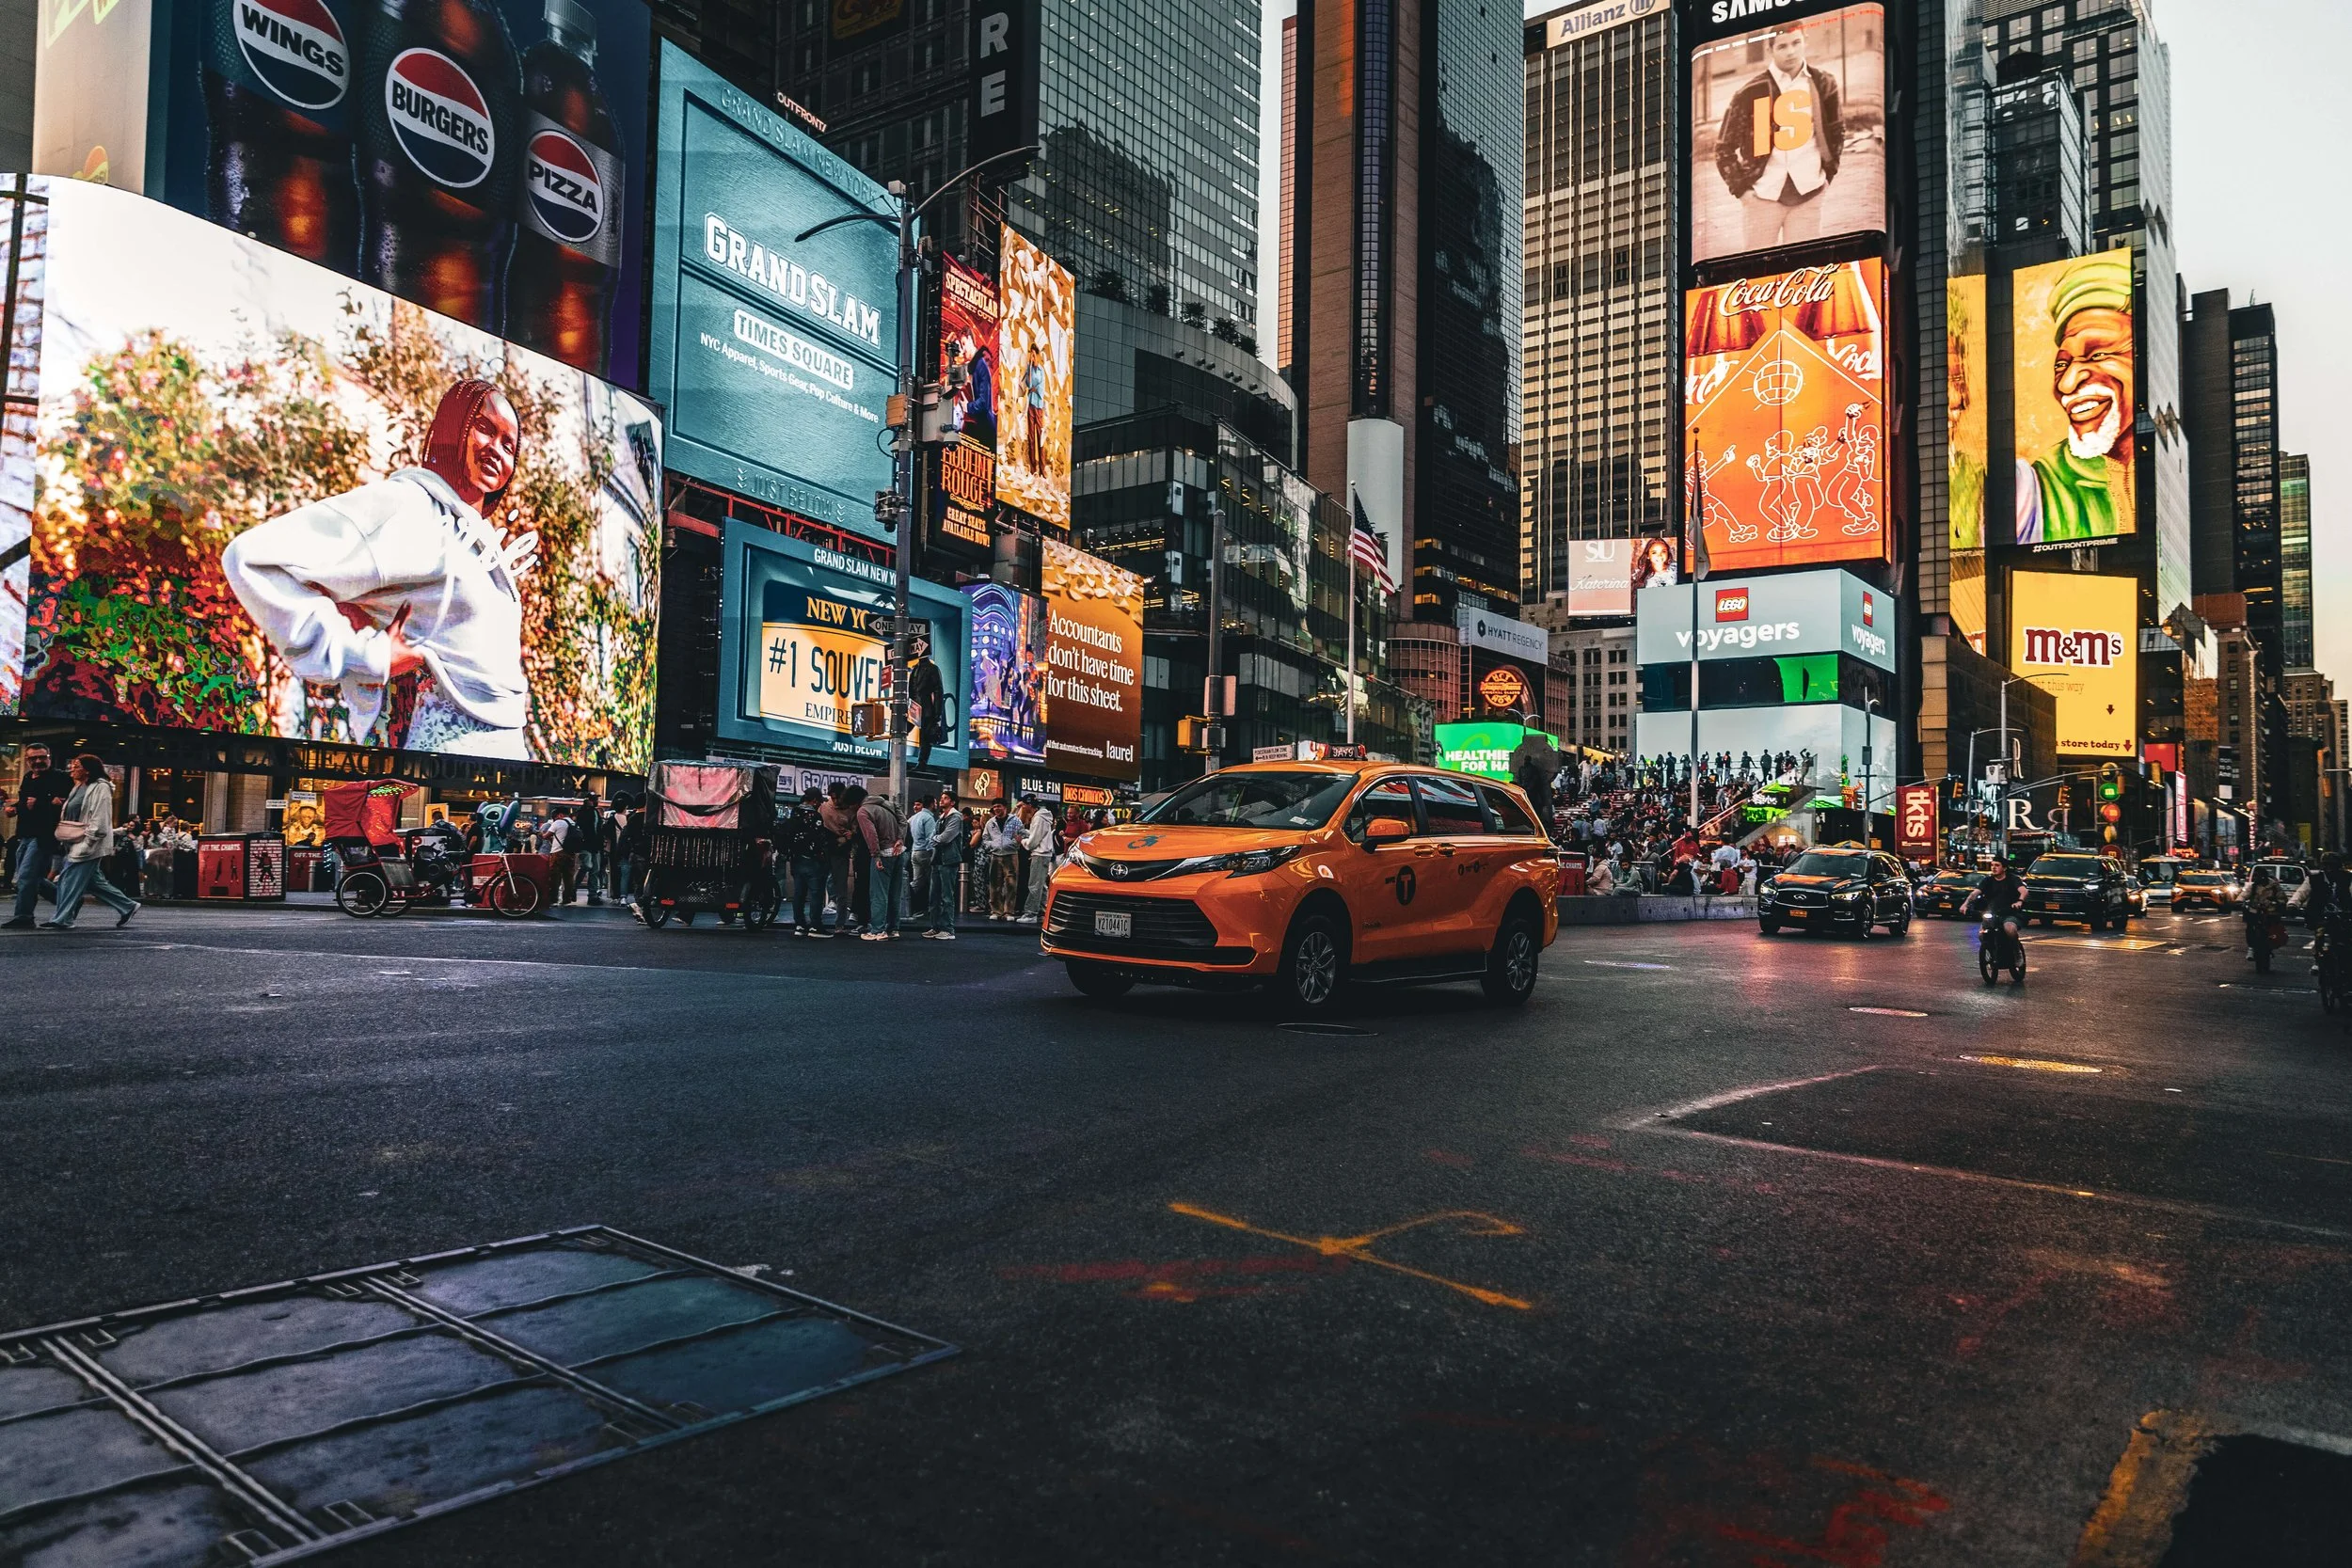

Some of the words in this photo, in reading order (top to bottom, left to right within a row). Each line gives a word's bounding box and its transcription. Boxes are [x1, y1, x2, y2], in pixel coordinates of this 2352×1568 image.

[1560, 3, 1627, 39] Allianz
[241, 2, 345, 78] WINGS
[391, 85, 489, 156] BURGERS
[1753, 88, 1814, 158] IS
[720, 86, 774, 136] GRAND
[774, 123, 812, 162] SLAM
[814, 149, 844, 183] NEW
[845, 166, 879, 206] YORK
[528, 158, 598, 214] PIZZA
[705, 211, 808, 309] GRAND
[808, 271, 882, 350] SLAM
[945, 271, 998, 319] SPECTACULAR
[1718, 262, 1840, 318] Coca-Cola
[949, 292, 977, 313] NIGHT
[738, 314, 788, 355] TIMES
[792, 341, 850, 386] SQUARE
[700, 331, 721, 353] NYC
[721, 342, 758, 372] Apparel,
[758, 359, 787, 383] Sports
[788, 372, 809, 394] Gear,
[809, 382, 825, 401] Pop
[825, 390, 853, 412] Culture
[860, 405, 880, 424] More
[942, 445, 987, 480] MOULIN
[750, 471, 785, 499] JUST
[788, 486, 835, 517] BELOW
[942, 518, 975, 543] AVAILABLE
[974, 531, 991, 547] NOW!
[946, 506, 968, 526] GREAT
[967, 514, 987, 532] SEATS
[1584, 541, 1615, 561] SU
[2031, 537, 2118, 554] #OUTFRONTPRIME
[814, 547, 846, 573] GRAND
[846, 558, 869, 578] SLAM
[870, 566, 889, 584] NEW
[1569, 574, 1629, 592] Katerina
[806, 595, 848, 626] NEW
[1717, 594, 1748, 613] LEGO
[875, 621, 895, 631] ONE
[1048, 609, 1122, 654] Accountants
[1487, 626, 1512, 642] HYATT
[1512, 631, 1544, 651] REGENCY
[1676, 621, 1801, 652] voyagers
[1851, 623, 1886, 657] voyagers
[769, 637, 798, 688] #1
[1048, 641, 1080, 672] don't
[1081, 648, 1108, 680] have
[1108, 658, 1135, 686] time
[1047, 670, 1067, 699] for
[1067, 675, 1089, 705] this
[1089, 683, 1123, 712] sheet.
[2047, 679, 2065, 692] this
[2066, 681, 2086, 695] way
[804, 702, 852, 726] EMPIRE
[1105, 740, 1134, 762] laurel
[2060, 738, 2089, 749] store
[2090, 740, 2121, 752] today
[1460, 761, 1487, 771] FOR
[1021, 777, 1044, 793] BLUE
[1046, 781, 1061, 795] FIN
[1065, 786, 1077, 801] DOS
[1077, 788, 1104, 805] CAMINOS
[1905, 789, 1931, 838] tkts
[2006, 799, 2043, 831] R
